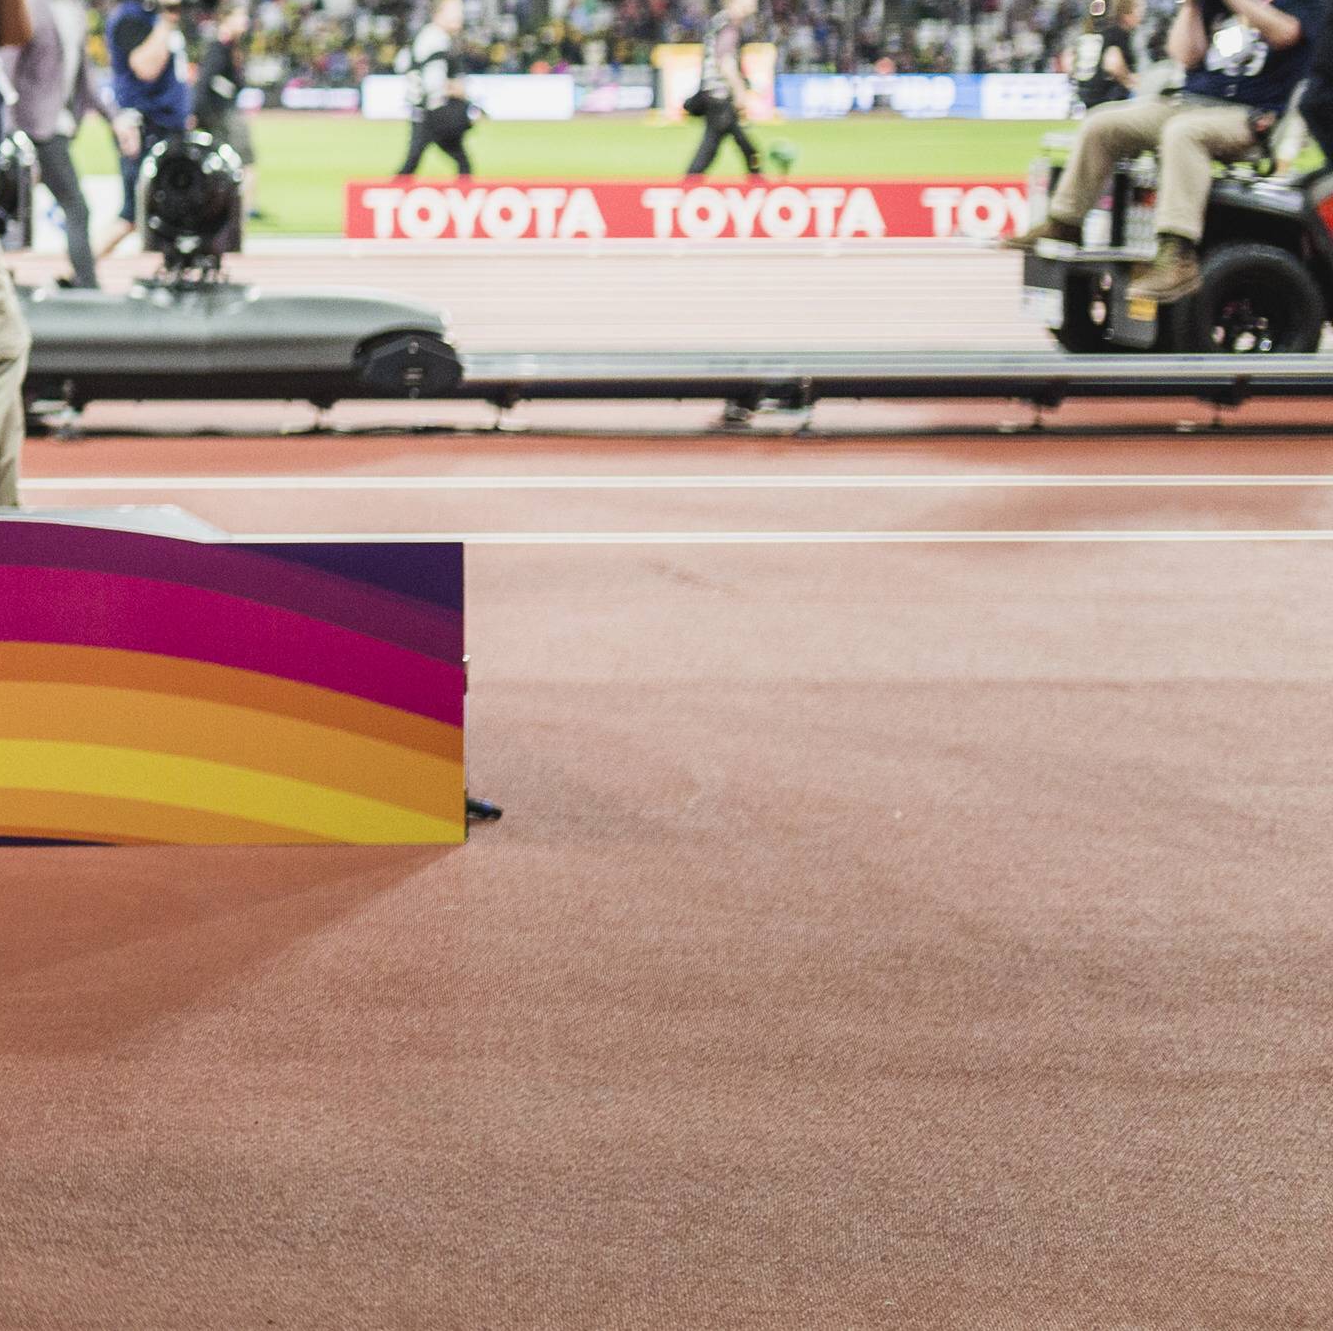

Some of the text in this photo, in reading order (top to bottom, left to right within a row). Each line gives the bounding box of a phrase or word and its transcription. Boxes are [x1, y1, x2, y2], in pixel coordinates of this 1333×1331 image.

[362, 185, 608, 238] TOYOTA
[642, 185, 887, 238] TOYOTA
[921, 185, 1030, 238] TOY
